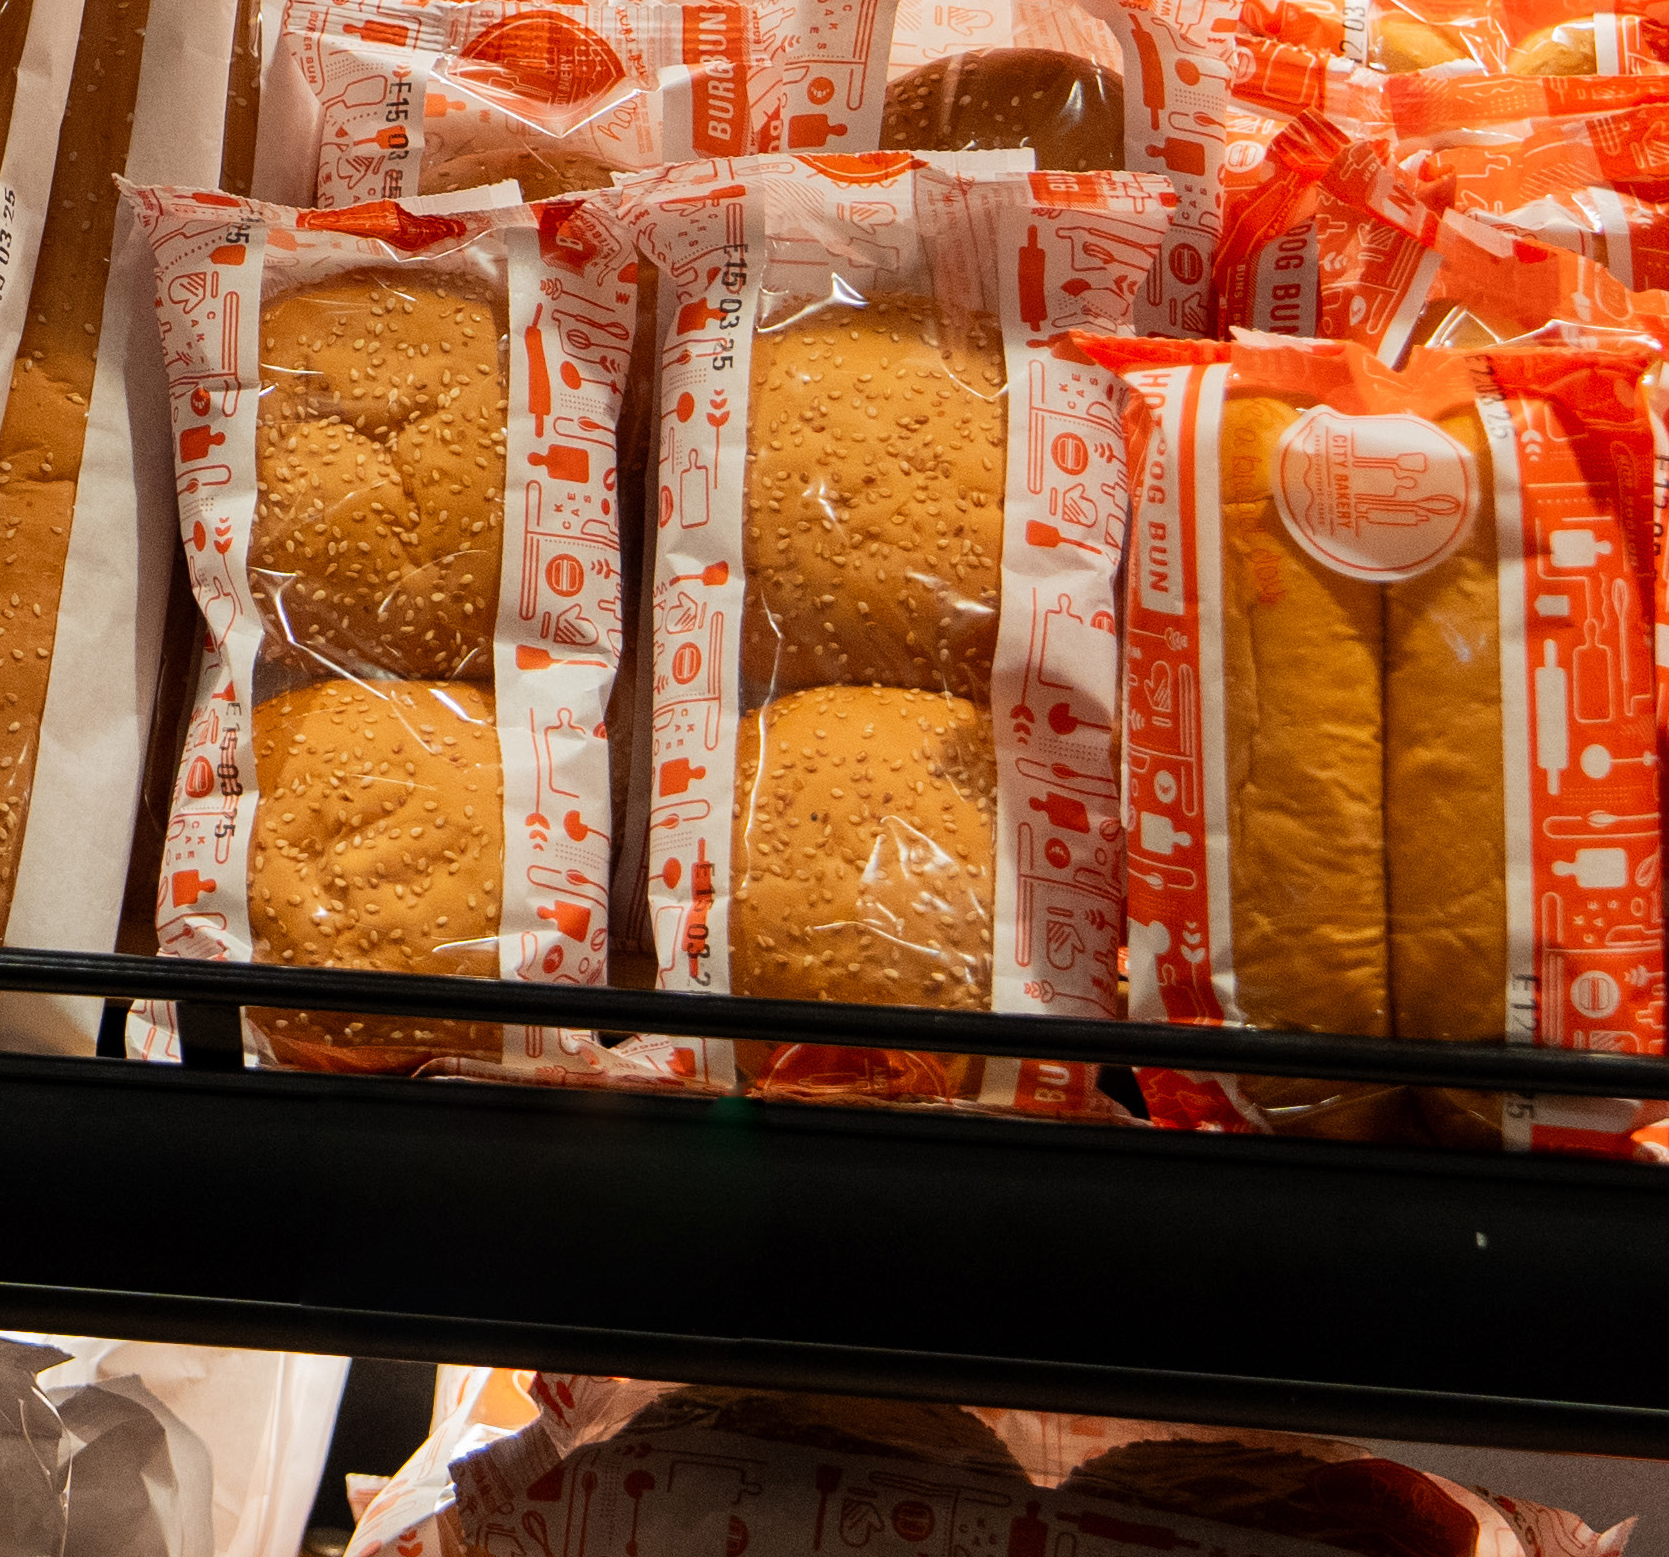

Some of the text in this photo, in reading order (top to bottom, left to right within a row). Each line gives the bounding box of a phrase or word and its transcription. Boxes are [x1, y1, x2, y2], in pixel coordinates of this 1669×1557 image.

[305, 57, 318, 85] BUN
[388, 81, 412, 123] E15
[387, 132, 410, 161] 03
[720, 243, 749, 287] E15
[718, 298, 743, 331] 03
[1058, 372, 1100, 410] CAKES
[1333, 434, 1353, 529] CITY BAKERY
[554, 490, 594, 531] CAKES
[1146, 521, 1170, 594] BUN
[216, 763, 243, 797] 03
[686, 923, 711, 960] 03
